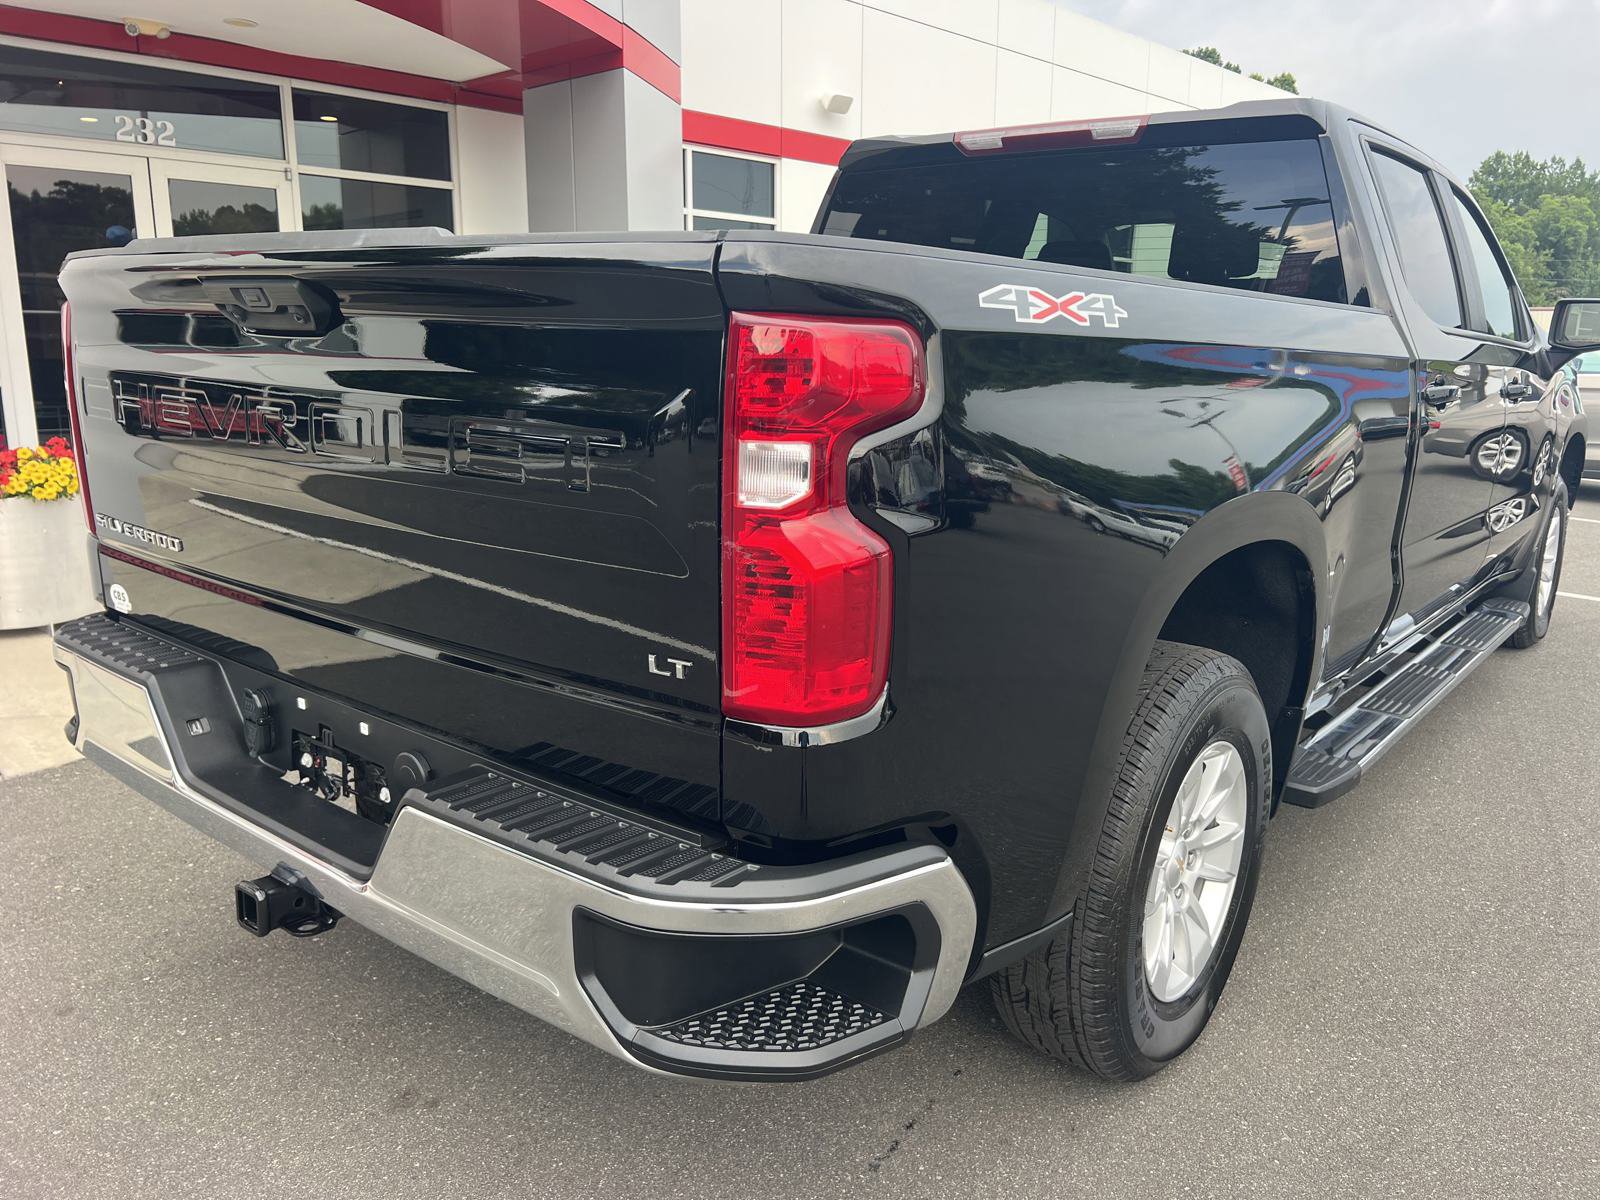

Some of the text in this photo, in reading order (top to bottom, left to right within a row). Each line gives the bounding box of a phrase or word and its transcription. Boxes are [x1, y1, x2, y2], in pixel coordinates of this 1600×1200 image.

[114, 115, 176, 147] 232
[95, 512, 184, 552] SILVERADO
[648, 653, 693, 680] LT
